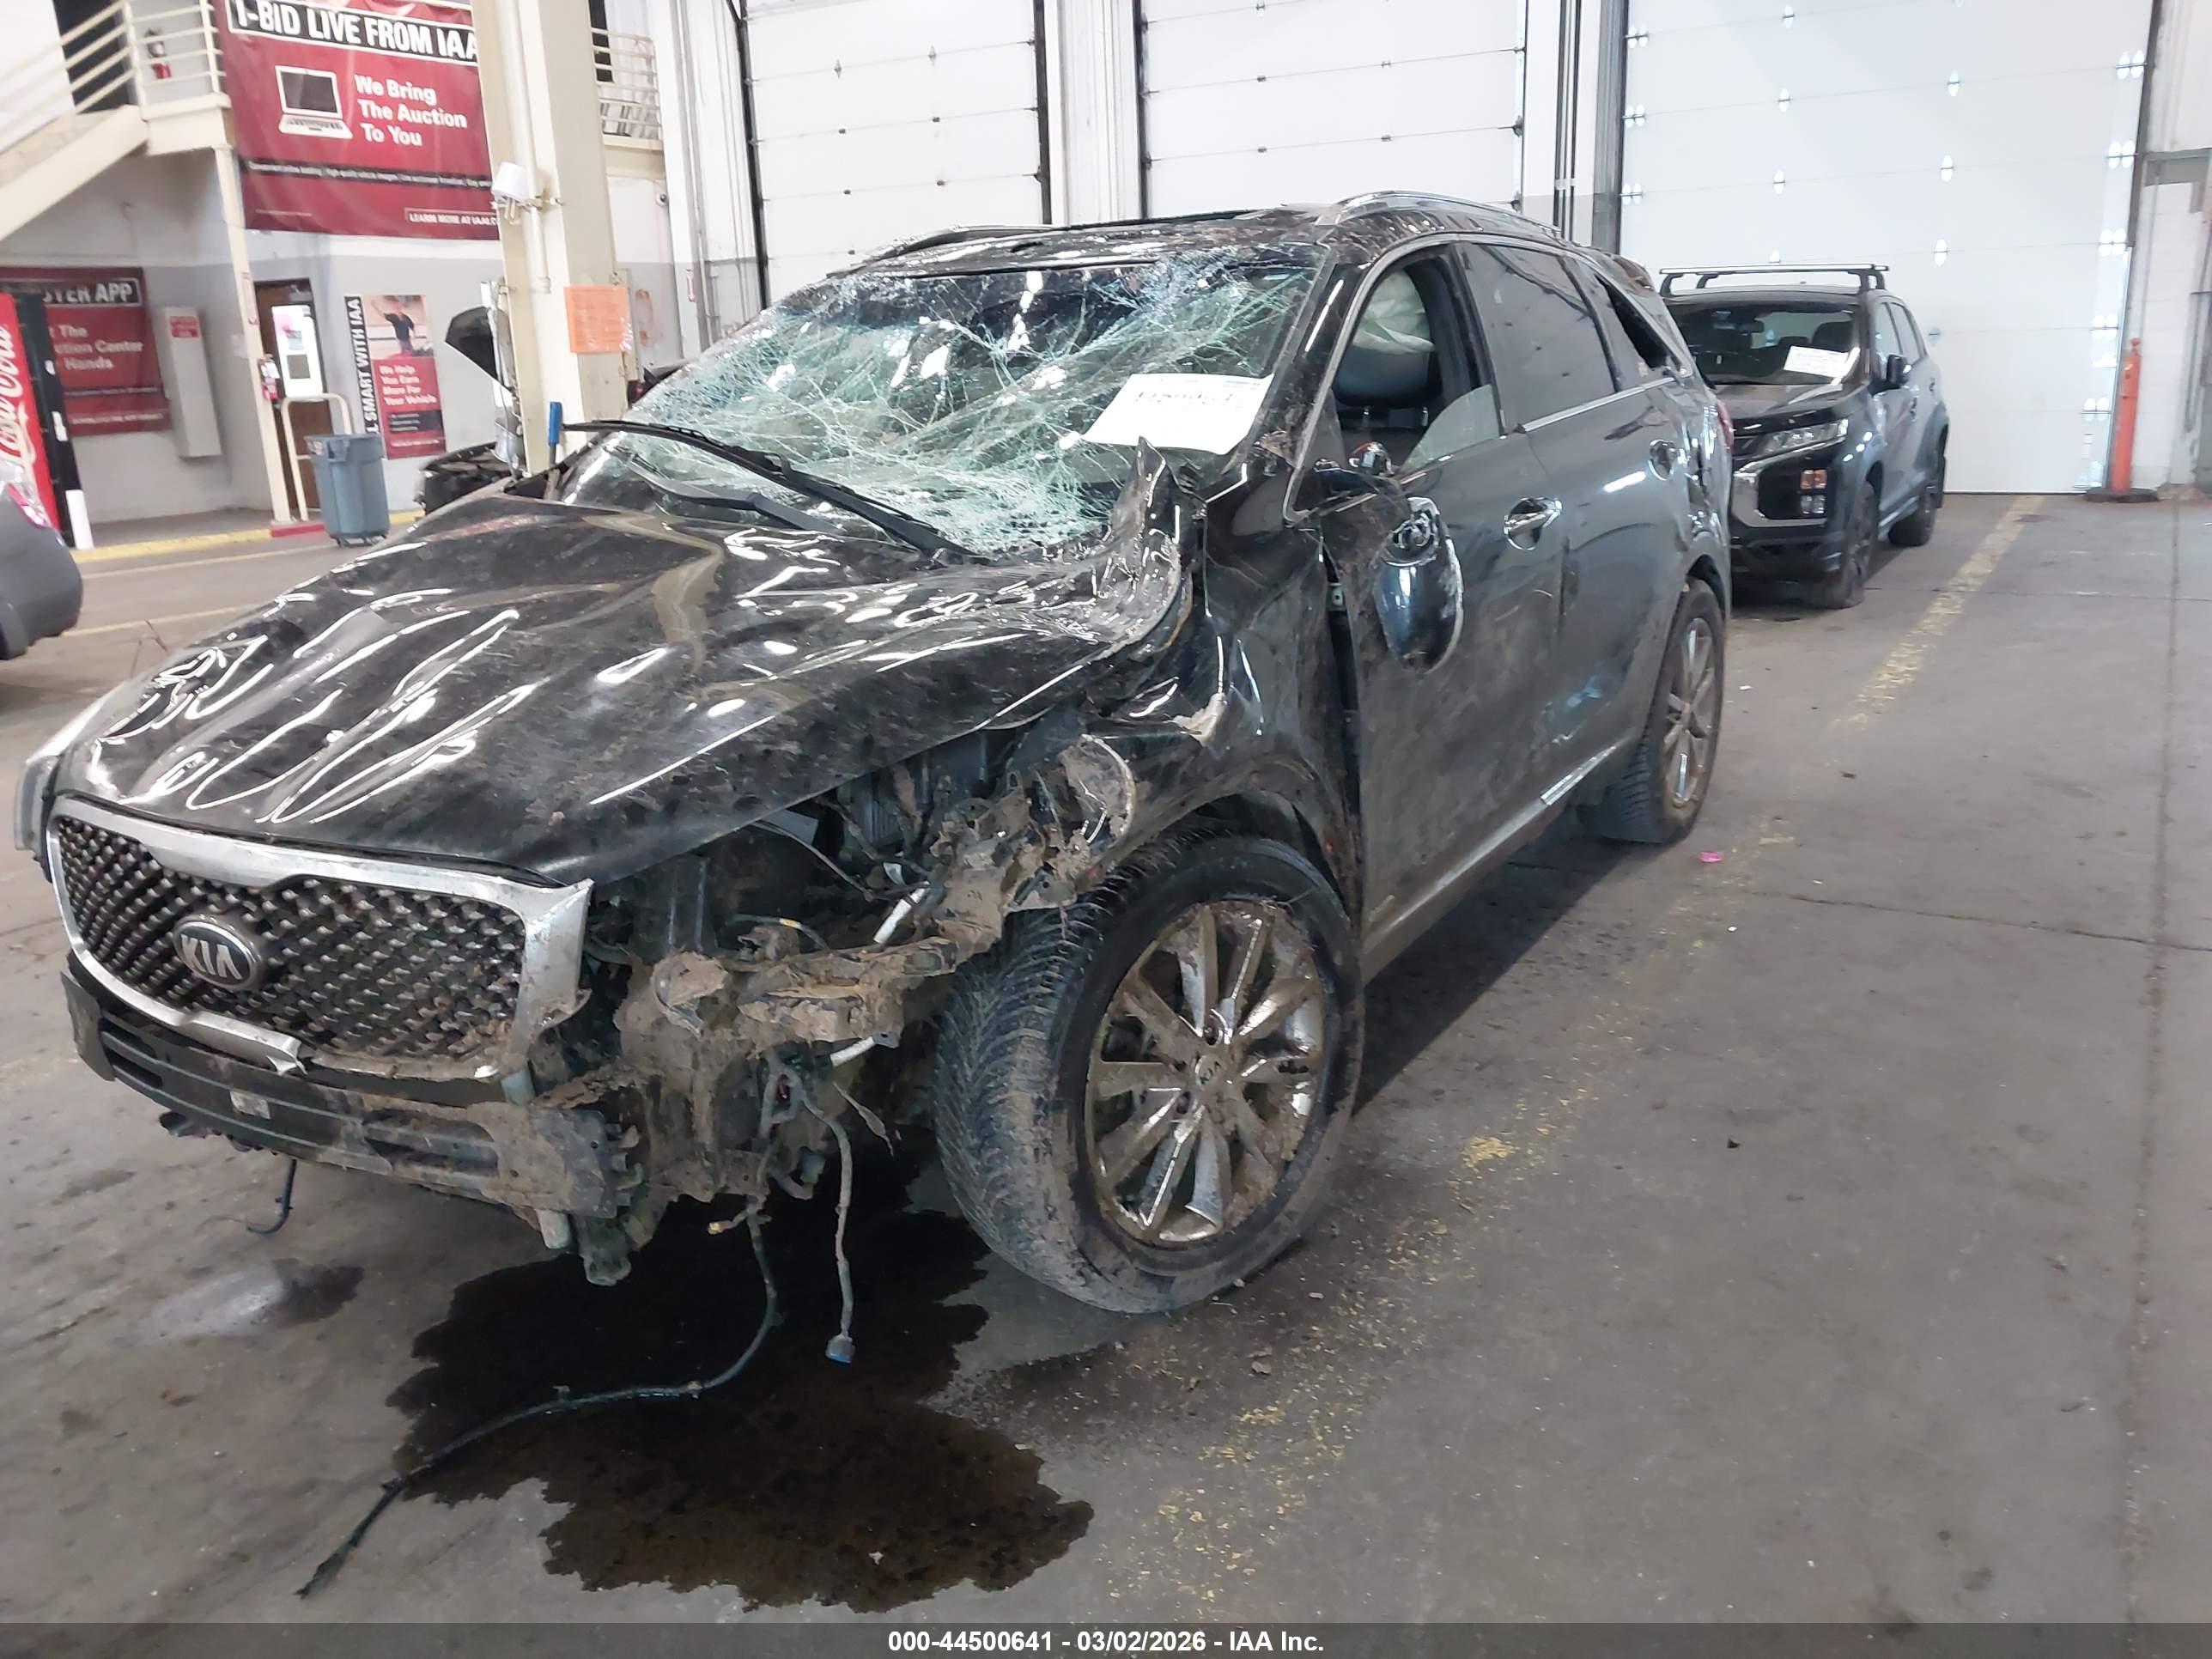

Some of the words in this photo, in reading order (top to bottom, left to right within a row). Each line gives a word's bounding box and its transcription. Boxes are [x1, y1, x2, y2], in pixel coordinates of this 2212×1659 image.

[307, 6, 362, 45] LIVE
[365, 16, 433, 54] FROM
[436, 27, 477, 59] IAA
[355, 74, 385, 96] We
[386, 78, 437, 106] Bring
[357, 98, 393, 121] The
[398, 103, 468, 128] Auction
[360, 122, 386, 143] To
[387, 124, 423, 147] You
[94, 283, 132, 302] APP
[347, 298, 362, 325] IAA
[94, 339, 143, 353] Center
[352, 328, 369, 369] WITH
[358, 370, 378, 422] SMART
[179, 933, 244, 981] KIA
